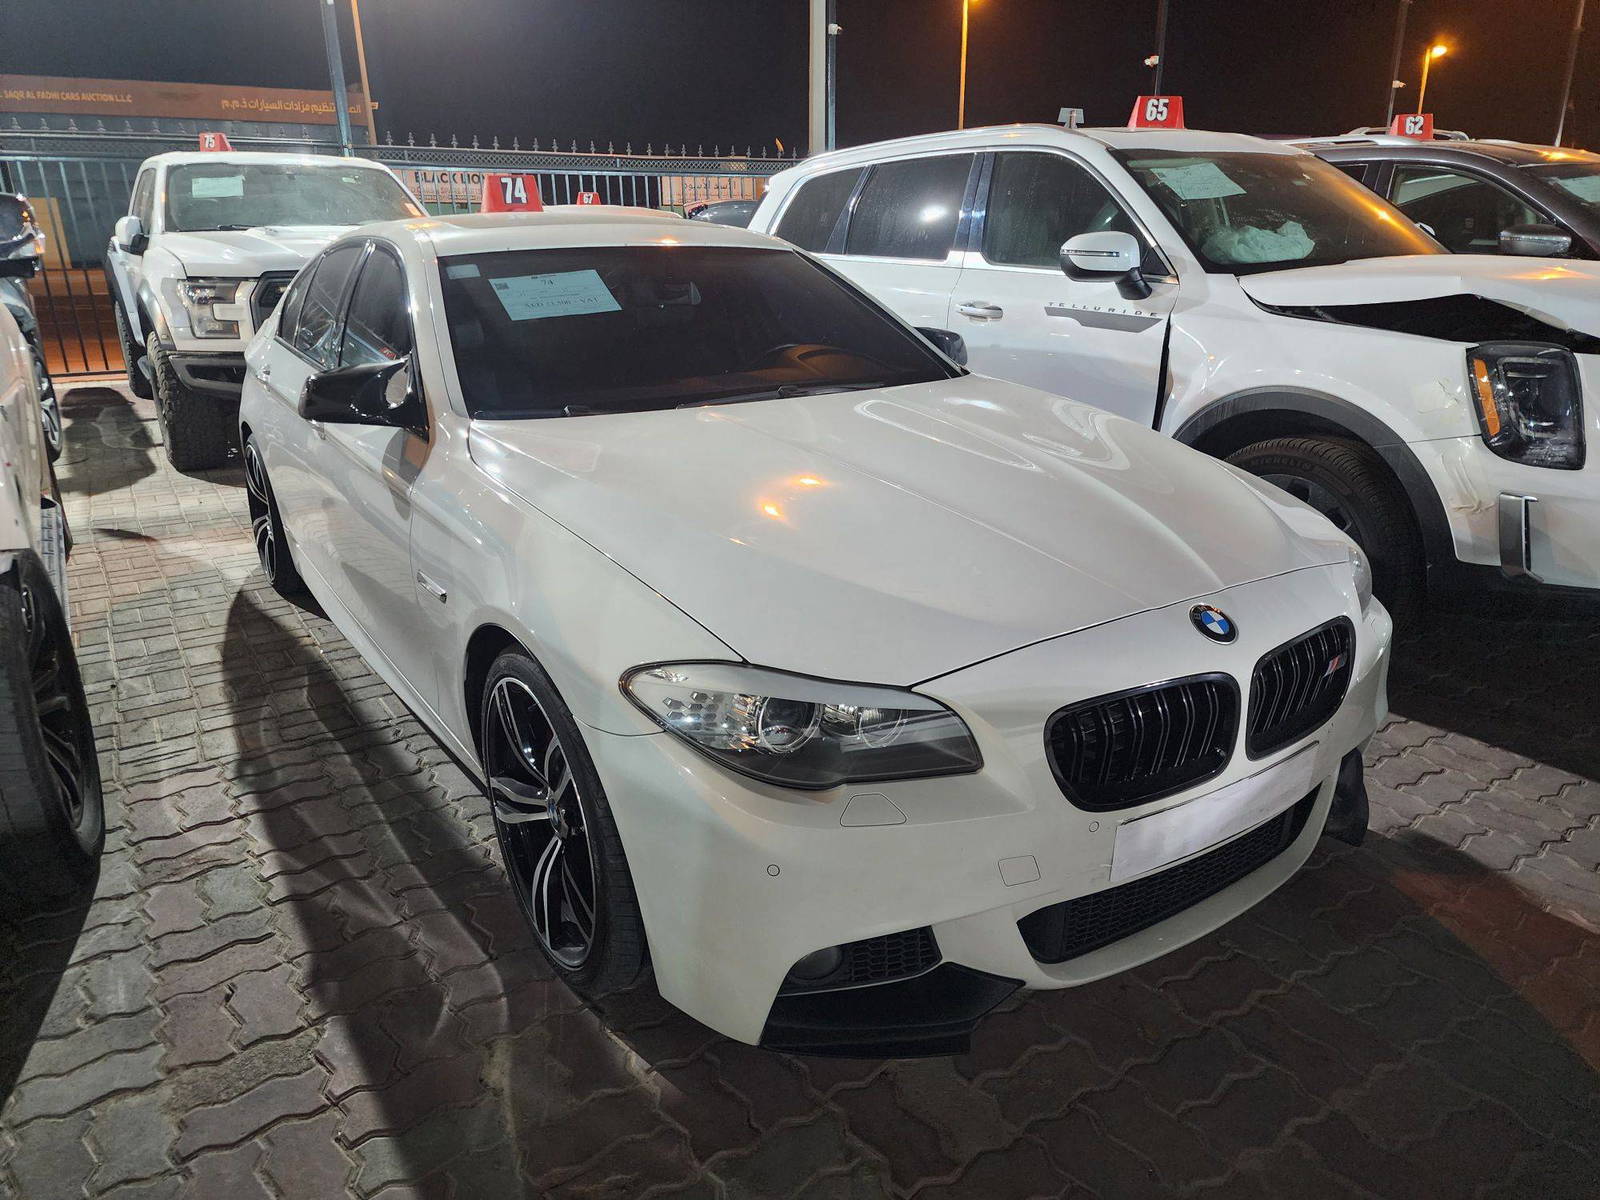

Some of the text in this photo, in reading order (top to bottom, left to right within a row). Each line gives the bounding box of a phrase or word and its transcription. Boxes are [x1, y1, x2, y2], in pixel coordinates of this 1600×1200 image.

[1146, 98, 1169, 121] 65
[1406, 116, 1424, 134] 62
[204, 135, 215, 148] 75
[501, 177, 527, 203] 74
[583, 193, 593, 204] 67
[1049, 301, 1158, 317] TELLURIDE
